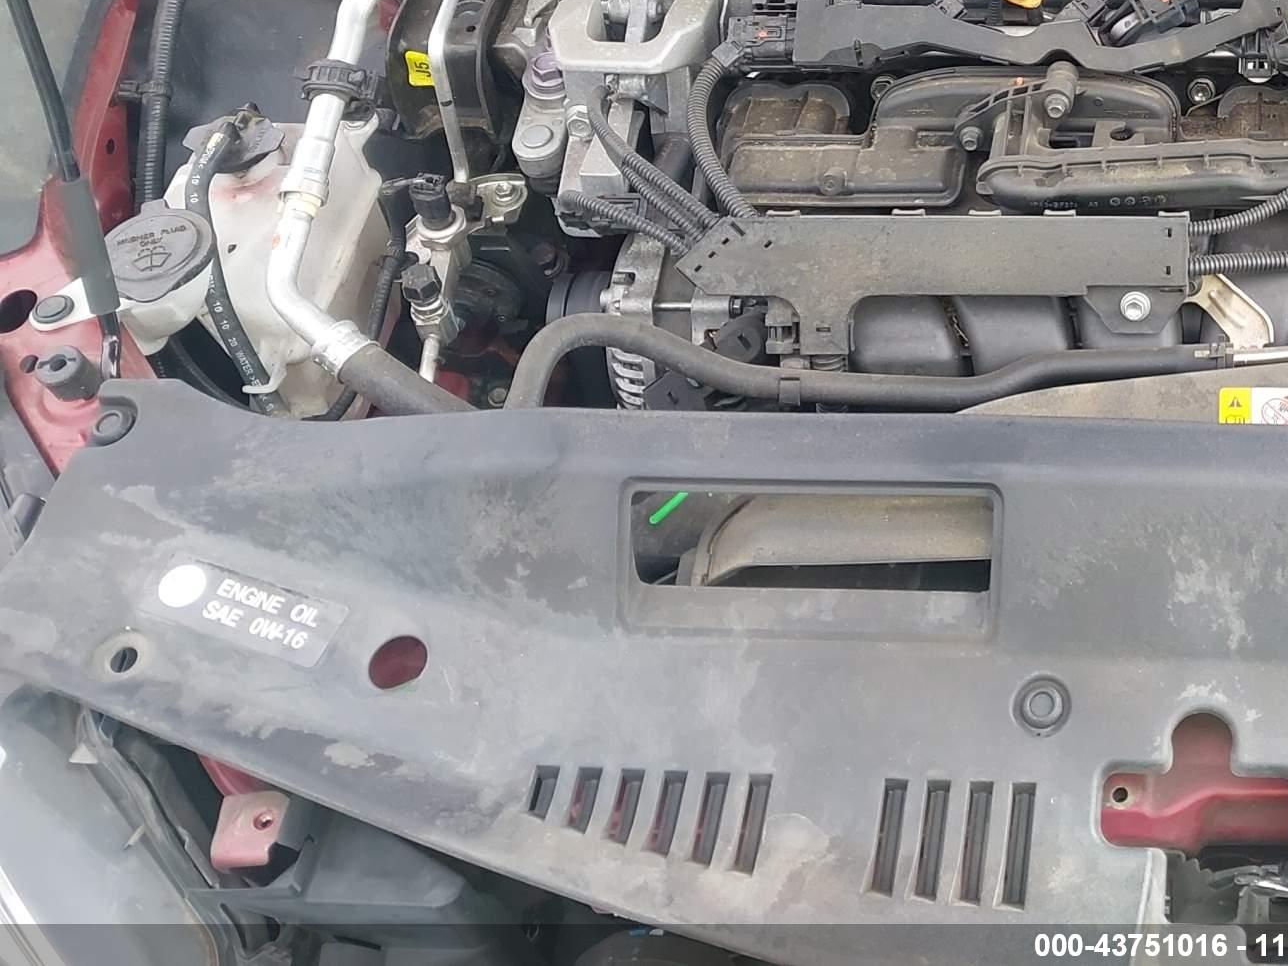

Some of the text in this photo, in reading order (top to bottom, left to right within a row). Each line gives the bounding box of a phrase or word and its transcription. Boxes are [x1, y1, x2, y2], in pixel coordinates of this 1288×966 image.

[414, 61, 431, 78] J5
[190, 192, 199, 203] 10
[116, 225, 187, 247] WASHER FLUID
[139, 237, 163, 248] ONLY
[213, 301, 223, 313] 10
[227, 337, 238, 348] 20
[235, 350, 254, 375] WATER
[216, 578, 319, 628] ENGINE OIL
[202, 600, 308, 649] SAE 0W-16
